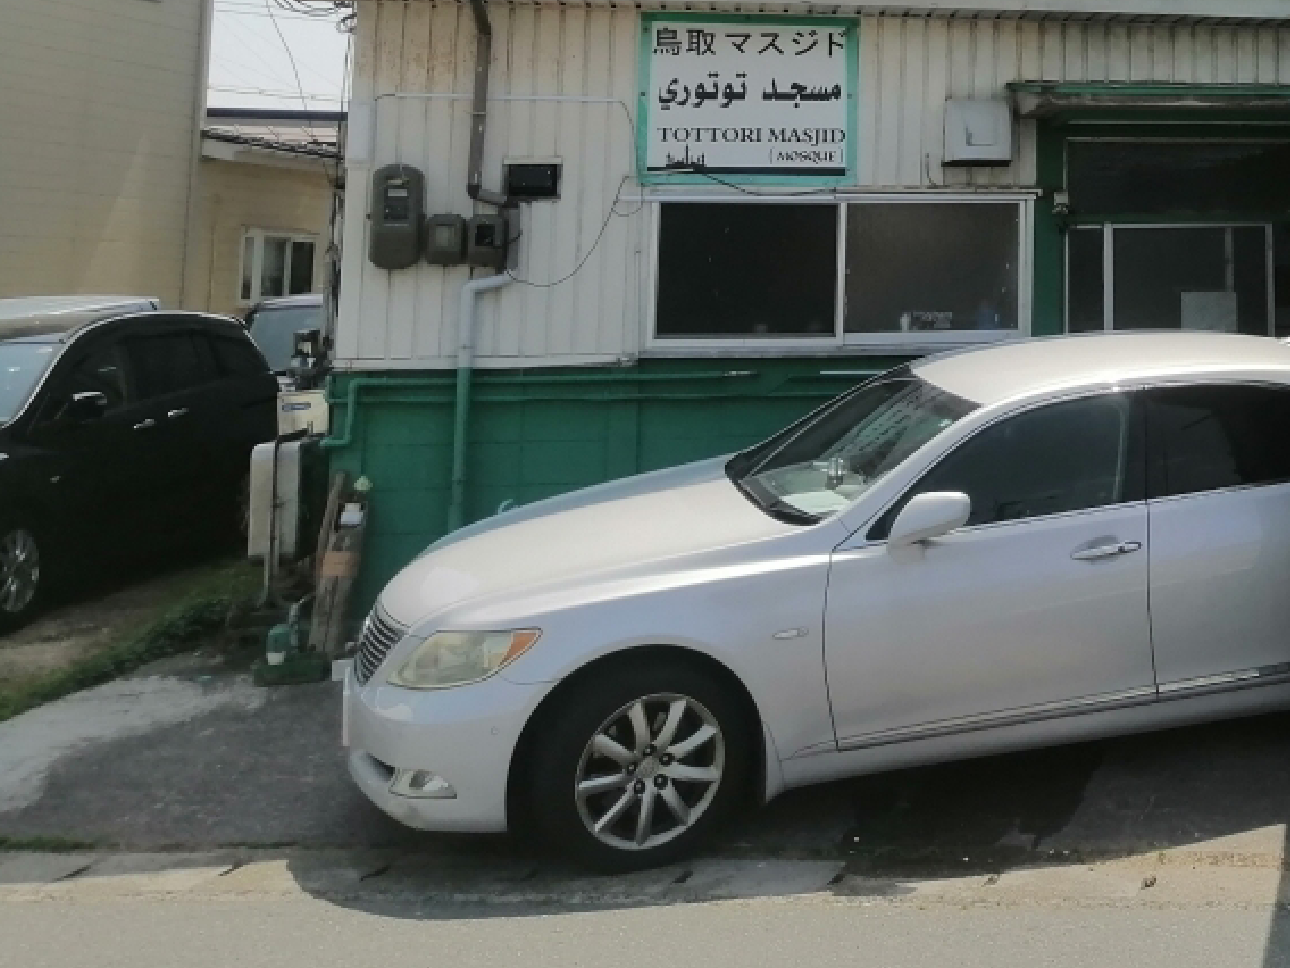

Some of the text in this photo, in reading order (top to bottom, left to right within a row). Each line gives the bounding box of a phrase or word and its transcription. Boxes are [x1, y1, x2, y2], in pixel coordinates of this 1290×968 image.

[762, 78, 842, 109] مسجد
[656, 128, 846, 146] TOTTORI MASJID
